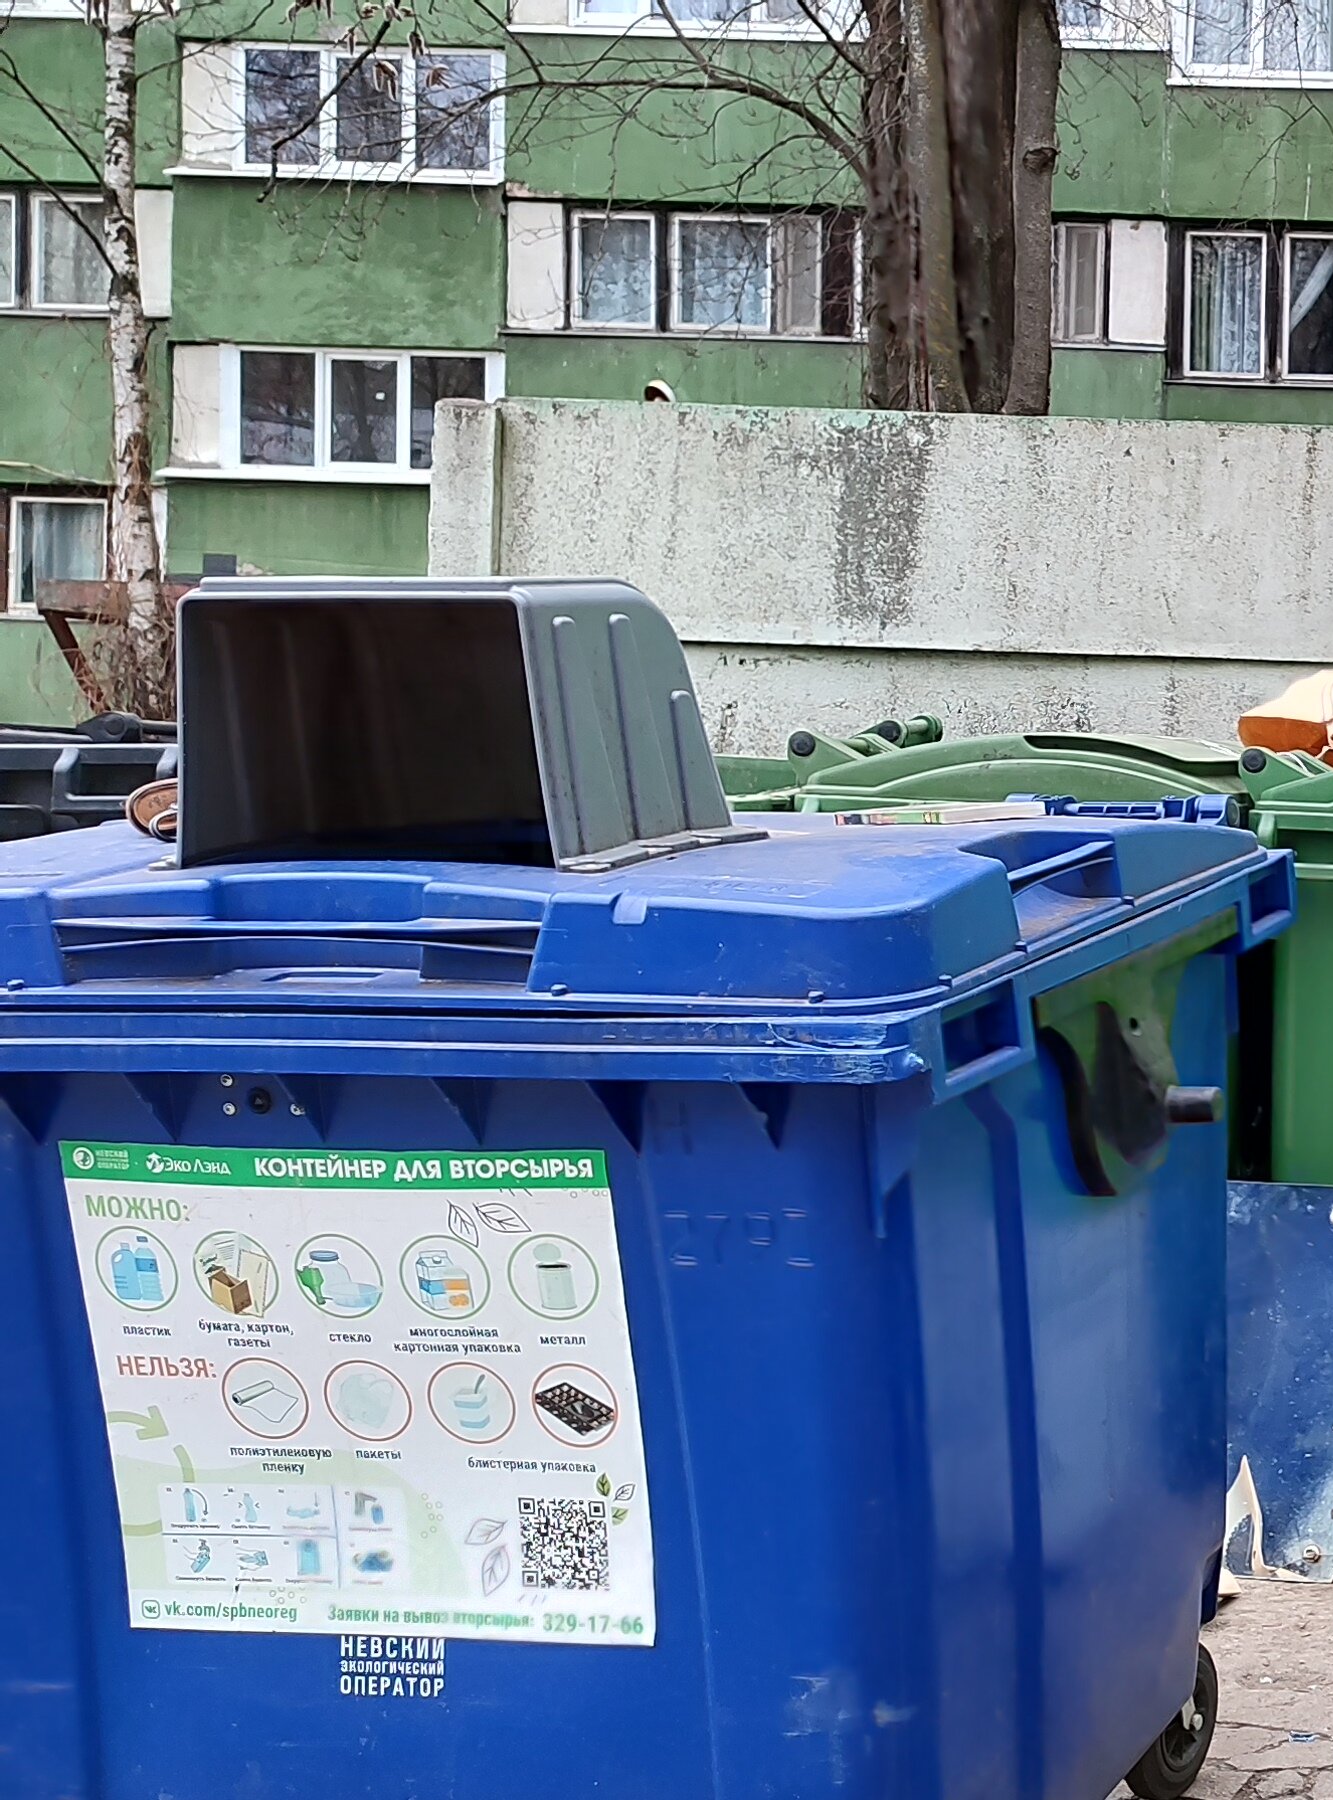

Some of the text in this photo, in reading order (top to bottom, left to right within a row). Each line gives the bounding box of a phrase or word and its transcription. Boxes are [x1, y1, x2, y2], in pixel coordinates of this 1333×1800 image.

[163, 1157, 192, 1173] Эко
[254, 1155, 594, 1182] КОНТЕЙНЕР ДЛЯ ВТОРСЫРЬЯ
[86, 1195, 190, 1223] МОЖНО:
[122, 1324, 172, 1338] пластик
[198, 1318, 295, 1337] бумага, картон,
[409, 1326, 499, 1339] многослойная
[227, 1337, 271, 1350] газеты
[328, 1332, 372, 1344] стекло
[539, 1334, 587, 1346] металл
[393, 1342, 522, 1357] картонная упаковка
[117, 1355, 218, 1379] НЕЛЬЗЯ:
[230, 1446, 333, 1460] полиэтиленовую
[355, 1448, 402, 1461] пакеты
[261, 1461, 306, 1476] пленку
[467, 1456, 597, 1474] блистерная упаковка
[164, 1601, 298, 1625] vk.com/spbneoreg
[327, 1605, 382, 1624] Заявки
[383, 1609, 400, 1624] на
[402, 1610, 449, 1626] вывоз
[541, 1612, 645, 1637] 329-17-66
[339, 1659, 445, 1676] ЭКОЛОГИЧЕСКИЙ
[339, 1674, 445, 1698] ОПЕРАТОР
